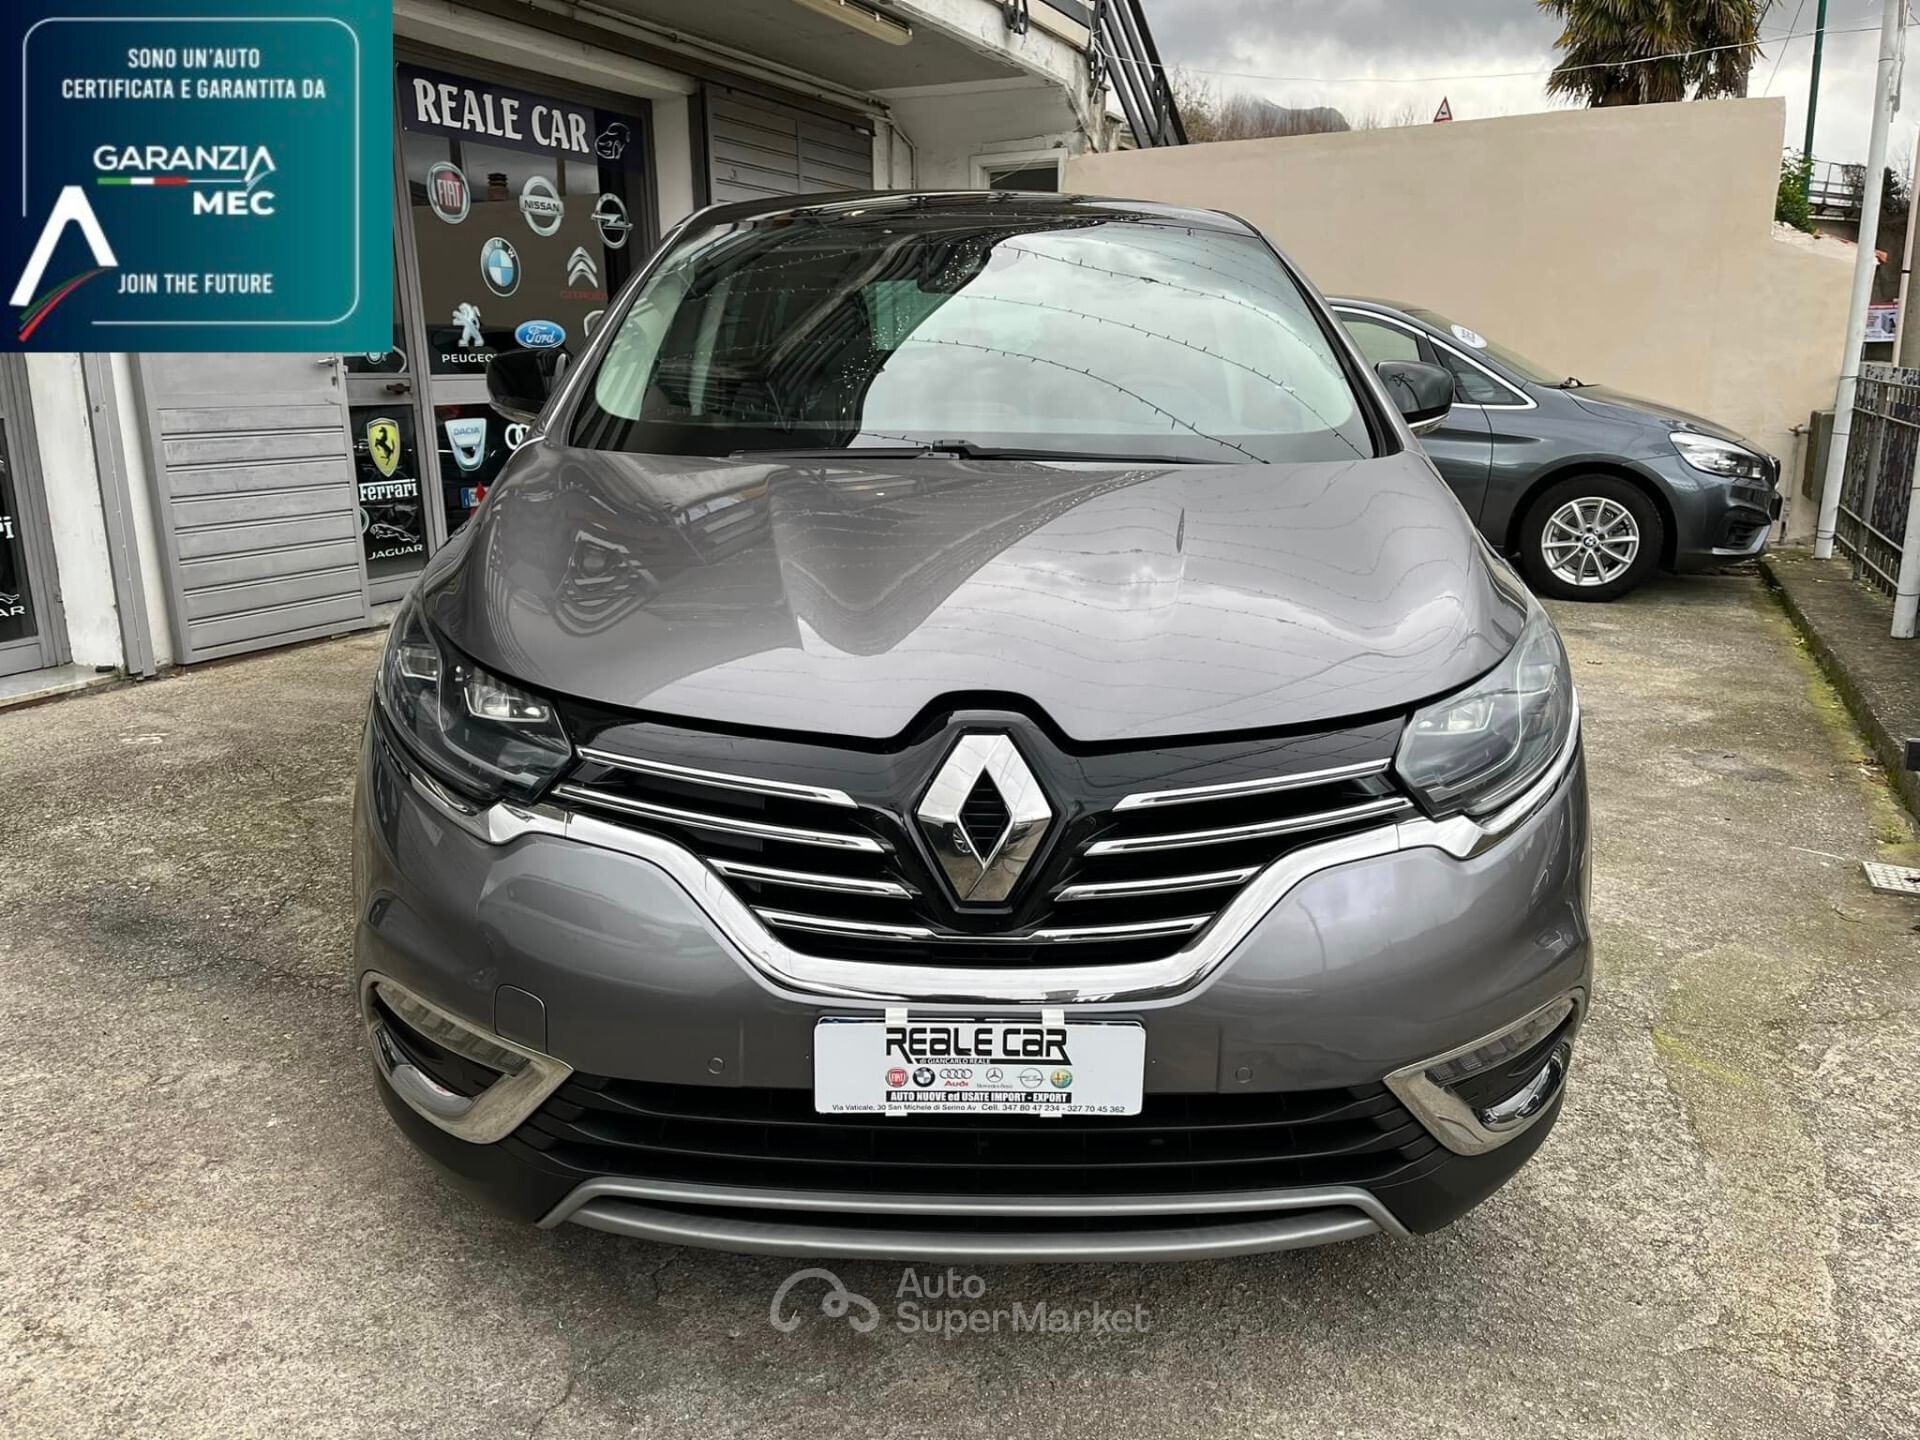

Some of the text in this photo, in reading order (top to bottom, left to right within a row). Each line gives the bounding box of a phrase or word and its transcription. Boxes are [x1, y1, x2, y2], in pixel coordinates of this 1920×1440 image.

[413, 78, 589, 153] REALE CAR
[437, 178, 461, 207] FIAT
[524, 199, 560, 212] NISSAN
[526, 325, 556, 343] Ford
[442, 353, 497, 363] PEUGEO
[453, 427, 480, 436] DACIA
[359, 478, 419, 502] Ferrari
[368, 544, 424, 560] JAGUAR
[890, 1091, 915, 1101] AUTO
[916, 1091, 947, 1101] NUOVE
[948, 1092, 960, 1101] ed
[961, 1092, 990, 1101] USATE
[991, 1092, 1026, 1102] IMPORT
[1033, 1093, 1068, 1102] EXPORT
[981, 1103, 999, 1111] Cell.
[1044, 1104, 1060, 1112] 234
